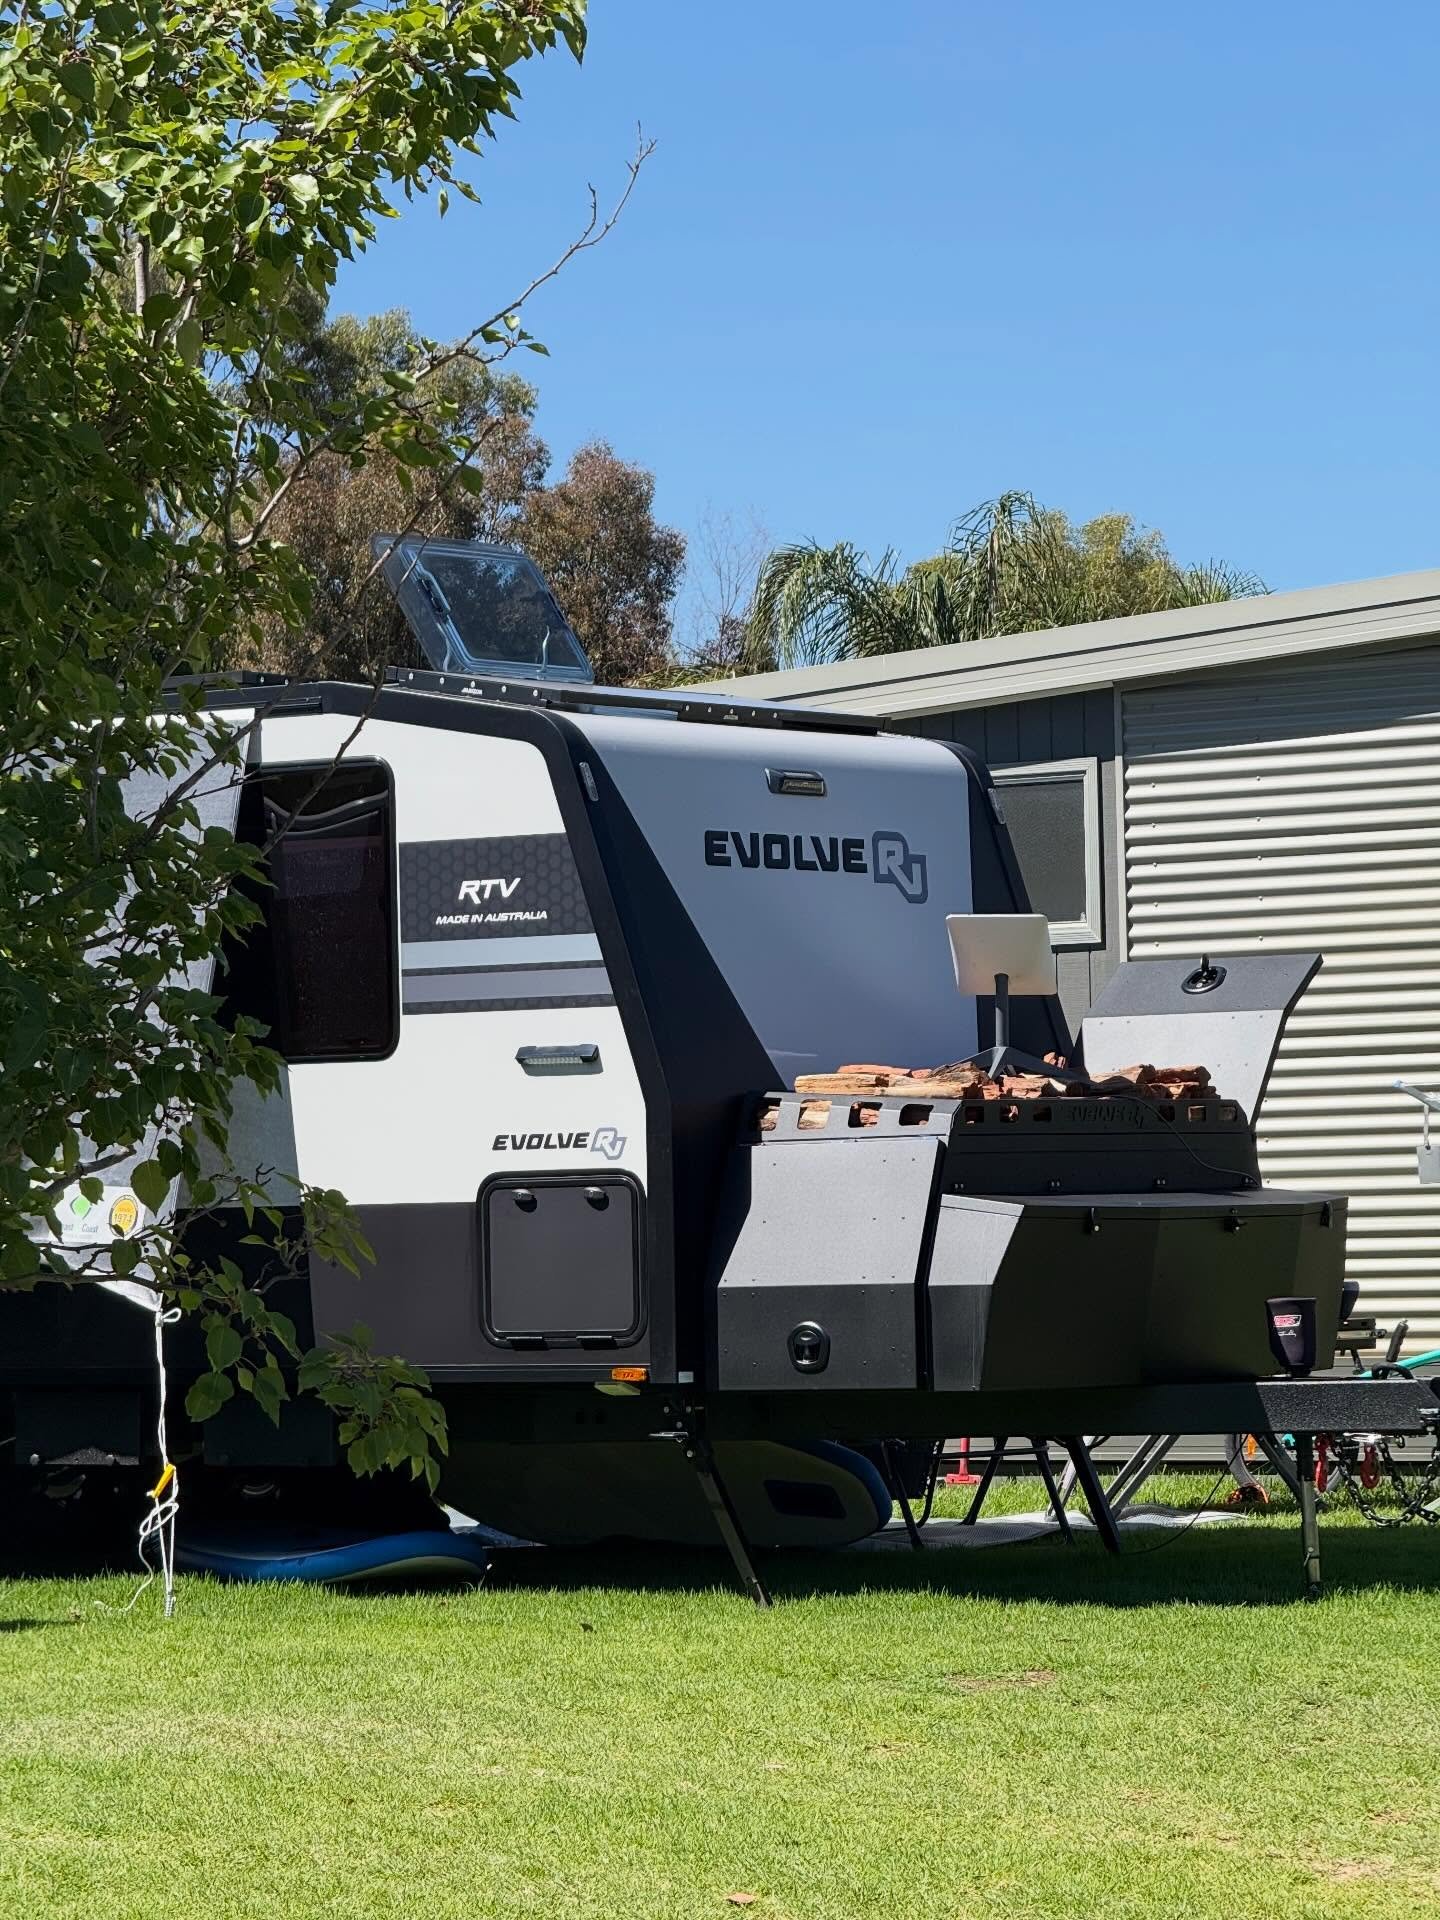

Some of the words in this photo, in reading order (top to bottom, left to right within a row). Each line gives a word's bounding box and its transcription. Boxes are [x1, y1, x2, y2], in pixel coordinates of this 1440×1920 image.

[704, 830, 868, 873] EVOLVE
[872, 830, 928, 904] RV
[458, 877, 521, 904] RTV
[435, 914, 470, 925] MADE
[471, 914, 483, 923] IN
[484, 910, 547, 922] AUSTRALIA
[492, 1132, 590, 1150] EVOLVE
